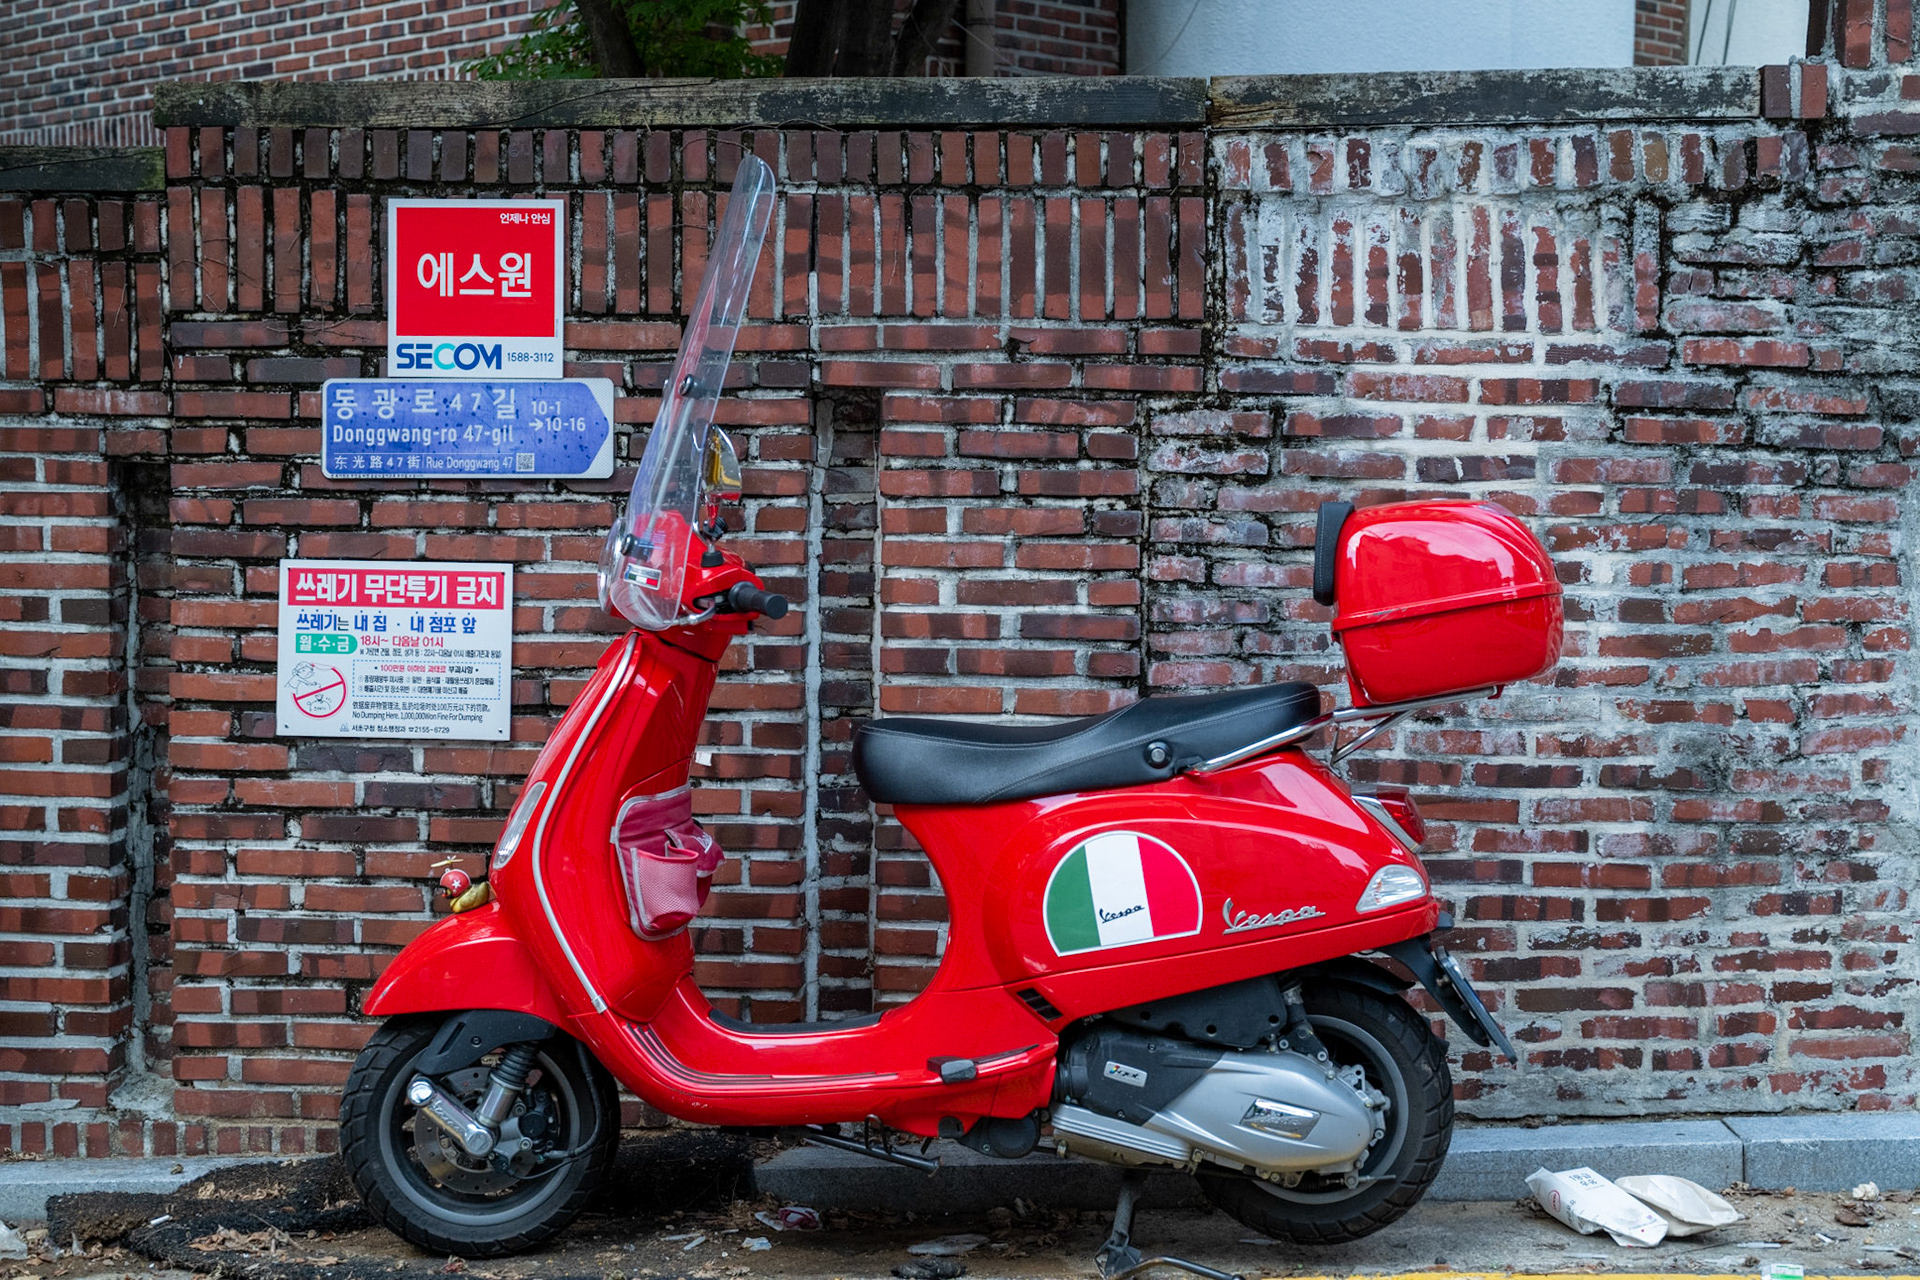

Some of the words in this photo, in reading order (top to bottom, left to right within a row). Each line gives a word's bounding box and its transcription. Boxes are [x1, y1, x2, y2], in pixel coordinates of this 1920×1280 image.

[500, 213, 528, 224] 언제나
[531, 213, 550, 224] 안심
[417, 252, 532, 297] 에스원
[396, 342, 502, 370] SECOM
[507, 352, 554, 362] 1588-3112
[531, 400, 561, 415] 10-1
[546, 417, 586, 432] 10-16
[333, 425, 457, 447] Donggwang-ro
[463, 425, 514, 445] 47-gil
[426, 456, 444, 468] Rue
[446, 455, 500, 472] Donggwang
[502, 456, 514, 468] 47
[295, 573, 357, 602] 쓰레기
[364, 575, 447, 604] 무단투기
[456, 576, 497, 605] 금지
[296, 613, 349, 631] 쓰레기는
[354, 614, 368, 632] 내
[373, 615, 387, 632] 집
[410, 616, 424, 633] 내
[429, 616, 456, 633] 점포
[462, 617, 477, 634] 앞
[392, 635, 420, 647] 다음날
[423, 636, 444, 648] 01시
[352, 711, 361, 719] No
[361, 711, 385, 721] Dumping
[437, 712, 448, 720] Fine
[458, 713, 483, 723] Dumping
[1099, 905, 1145, 924] Vespa
[1222, 897, 1326, 935] Vespa
